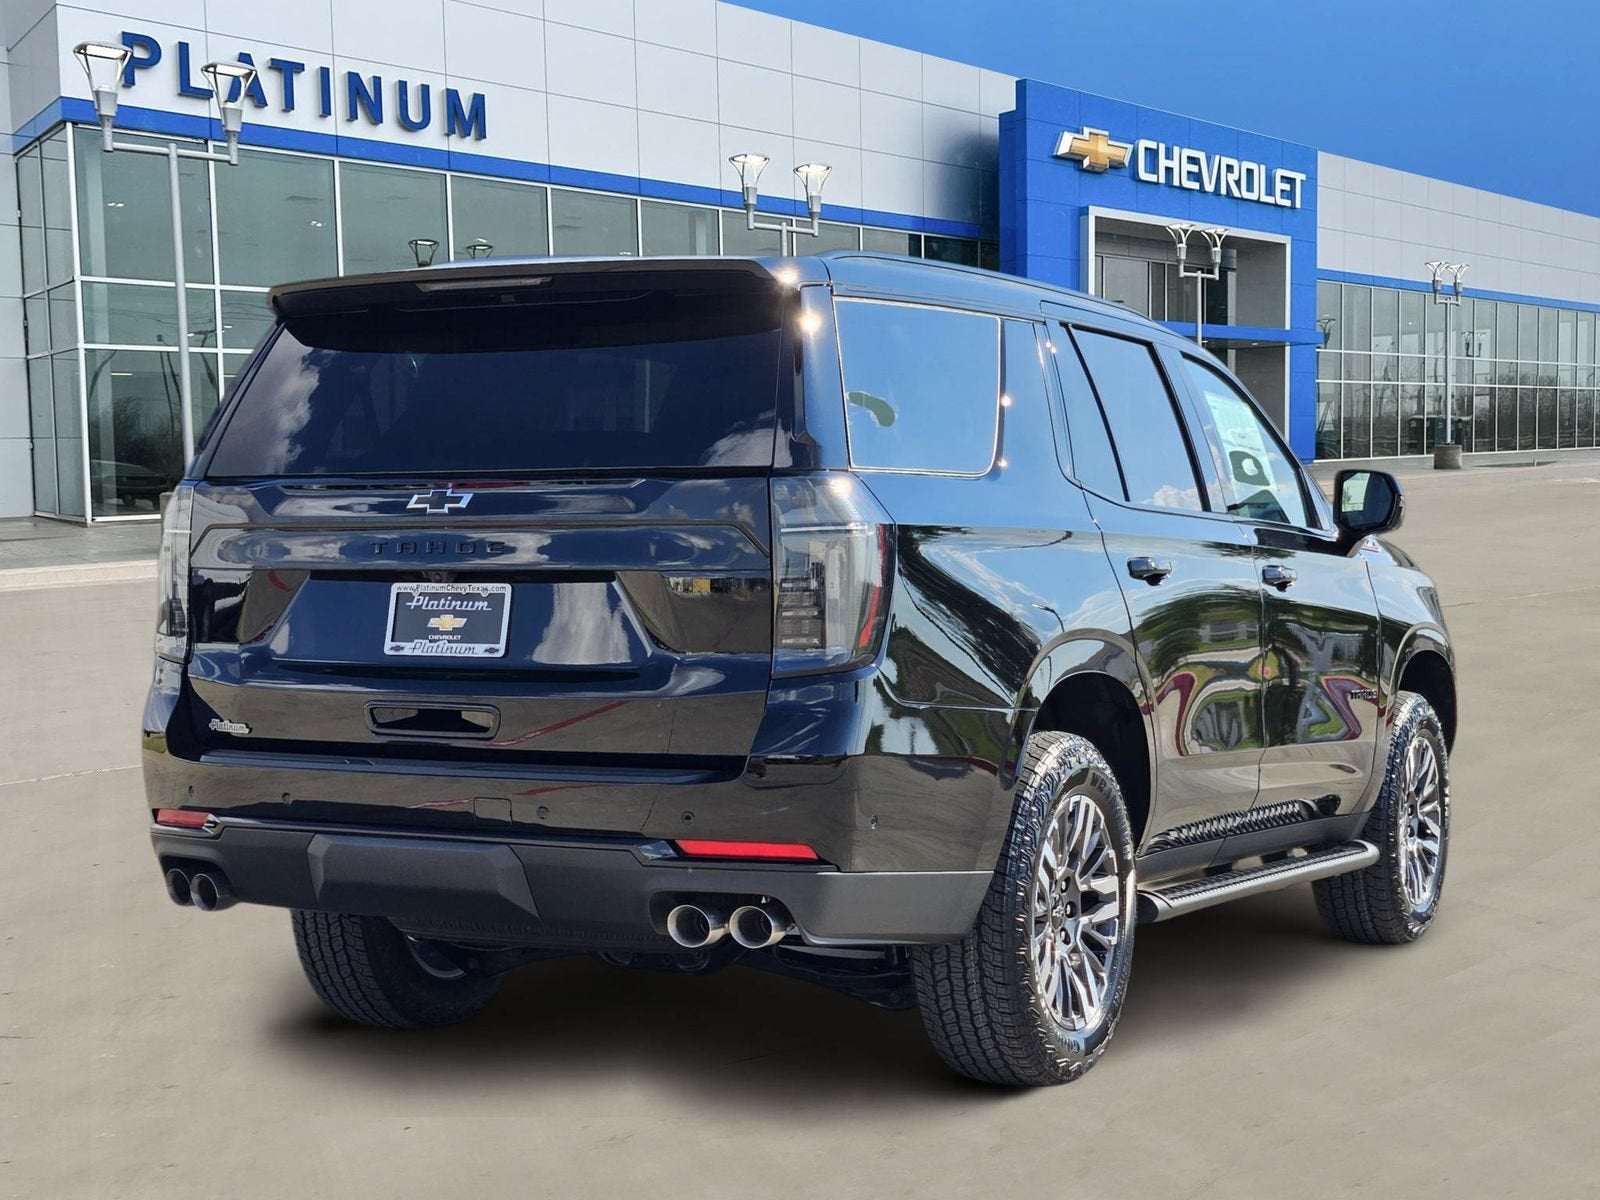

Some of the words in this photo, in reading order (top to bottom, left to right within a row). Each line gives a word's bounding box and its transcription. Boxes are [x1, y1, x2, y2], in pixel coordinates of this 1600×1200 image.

[121, 31, 487, 140] PLATINUM
[1135, 139, 1306, 208] CHEVROLET
[370, 541, 506, 555] TAHOE
[406, 596, 492, 611] Platinum
[408, 641, 478, 655] Platinum
